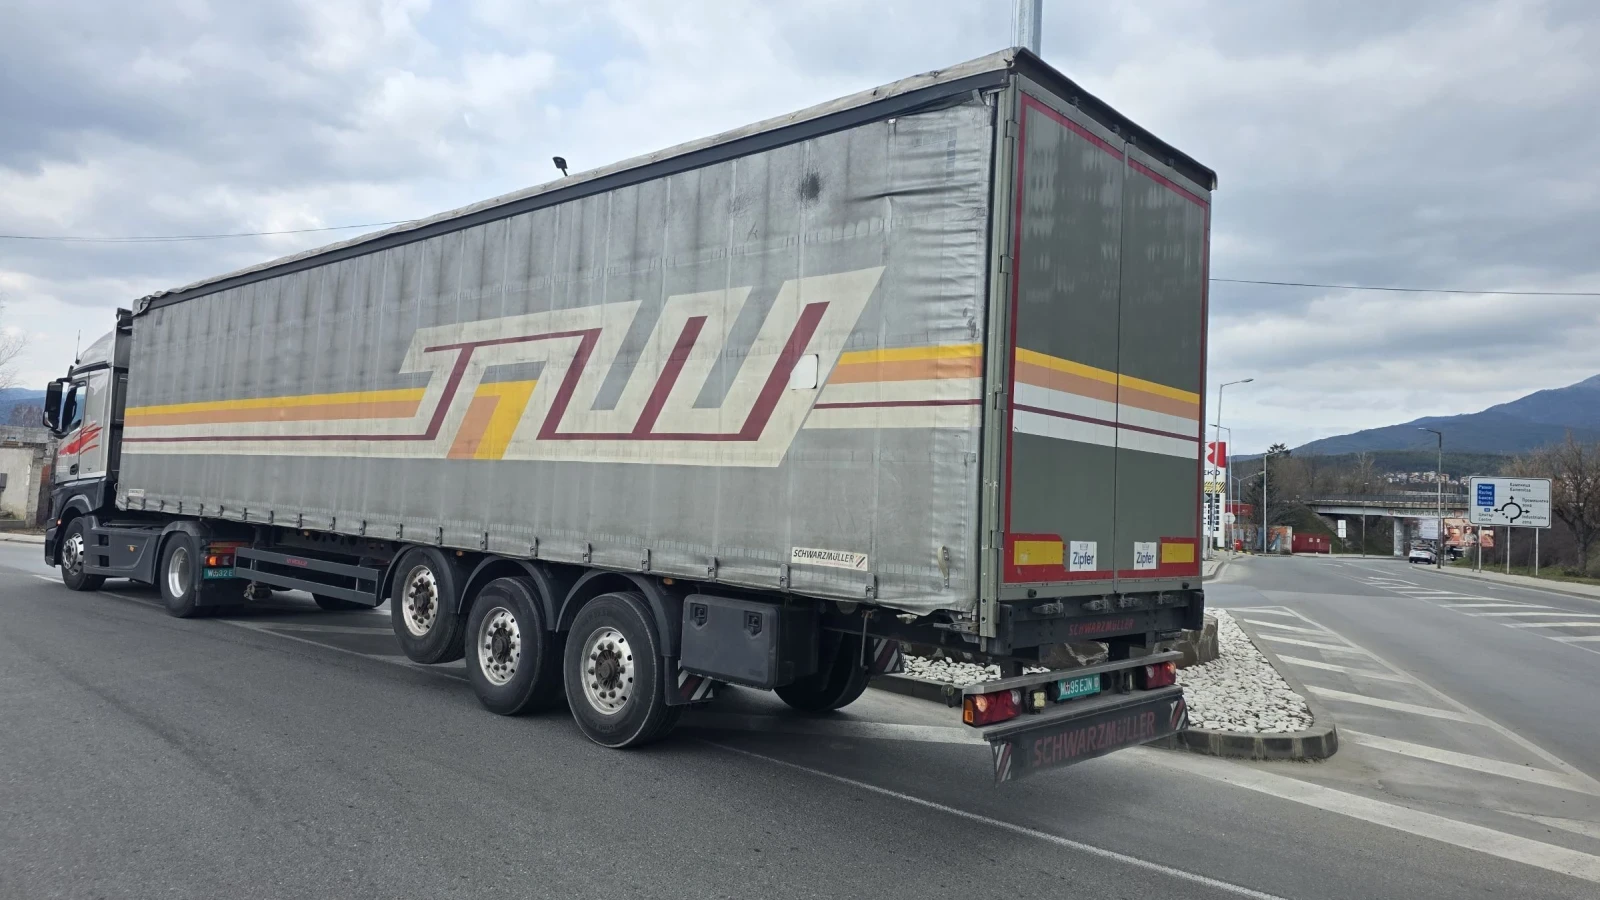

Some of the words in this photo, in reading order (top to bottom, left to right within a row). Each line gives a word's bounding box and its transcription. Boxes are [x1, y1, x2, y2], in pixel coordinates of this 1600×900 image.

[793, 549, 855, 563] SCHWARZMÜLLER
[1072, 551, 1095, 569] Zipfer
[1136, 549, 1155, 568] Zipfer
[1068, 618, 1135, 636] SCHWARZMÜLLER
[1032, 711, 1156, 767] SCHWARZMÜLLER
